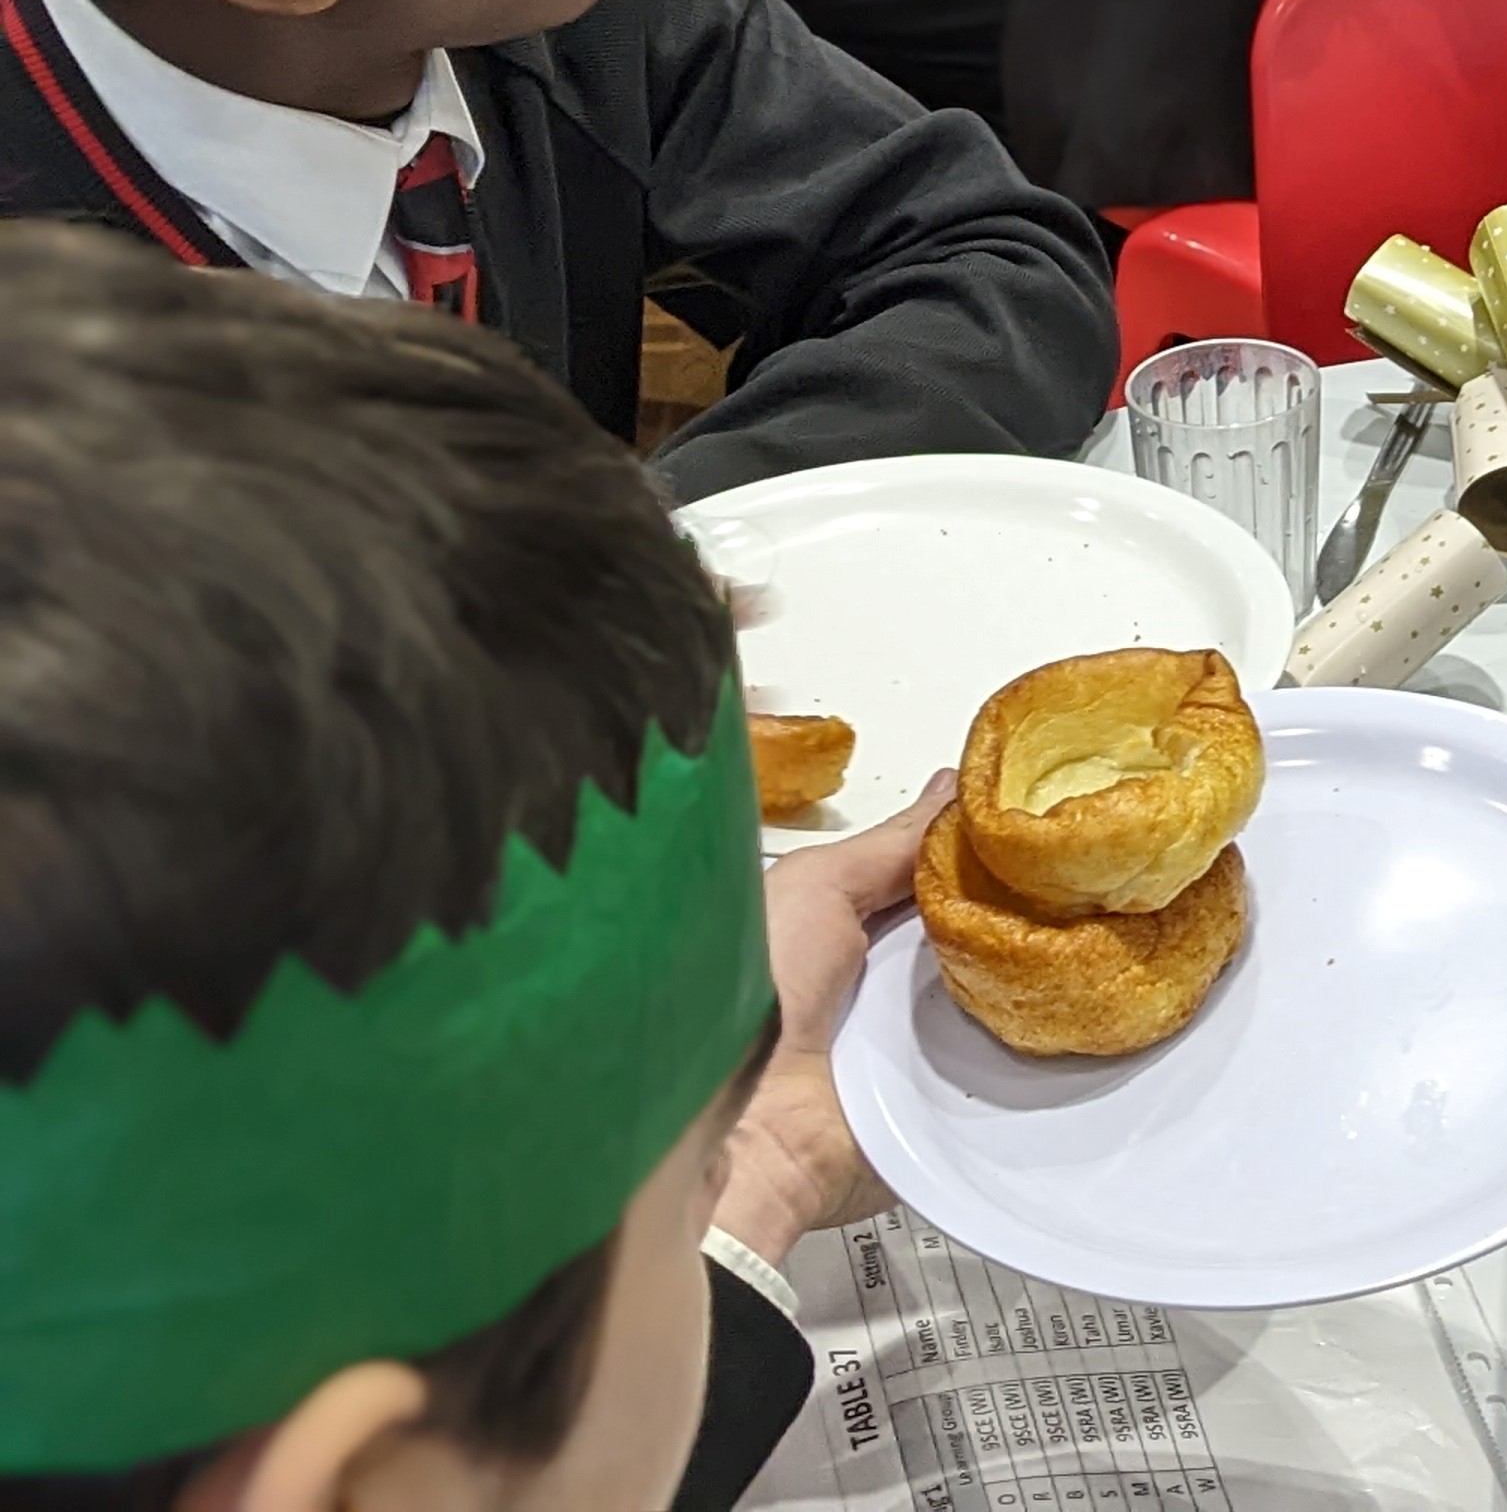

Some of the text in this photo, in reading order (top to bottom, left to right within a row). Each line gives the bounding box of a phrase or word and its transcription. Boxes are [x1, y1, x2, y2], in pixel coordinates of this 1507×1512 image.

[921, 1236, 940, 1249] M
[853, 1232, 886, 1289] Sitting 2
[915, 1319, 939, 1363] Name
[951, 1319, 972, 1359] Finley
[1014, 1307, 1038, 1350] Joshua
[1050, 1314, 1069, 1346] Kiran
[1082, 1314, 1101, 1345] Taha
[1113, 1308, 1134, 1344] Umar
[828, 1349, 879, 1451] TABLE 37
[975, 1416, 1000, 1451] 9SCE
[1008, 1413, 1035, 1446] 9SCE
[1042, 1410, 1068, 1443] 9SCE
[1077, 1408, 1101, 1442] 9SRA
[1109, 1406, 1133, 1442] 9SRA
[1141, 1405, 1167, 1441] 9SRA
[1173, 1404, 1199, 1439] 9SRA
[1166, 1484, 1183, 1494] A
[1196, 1478, 1216, 1492] W
